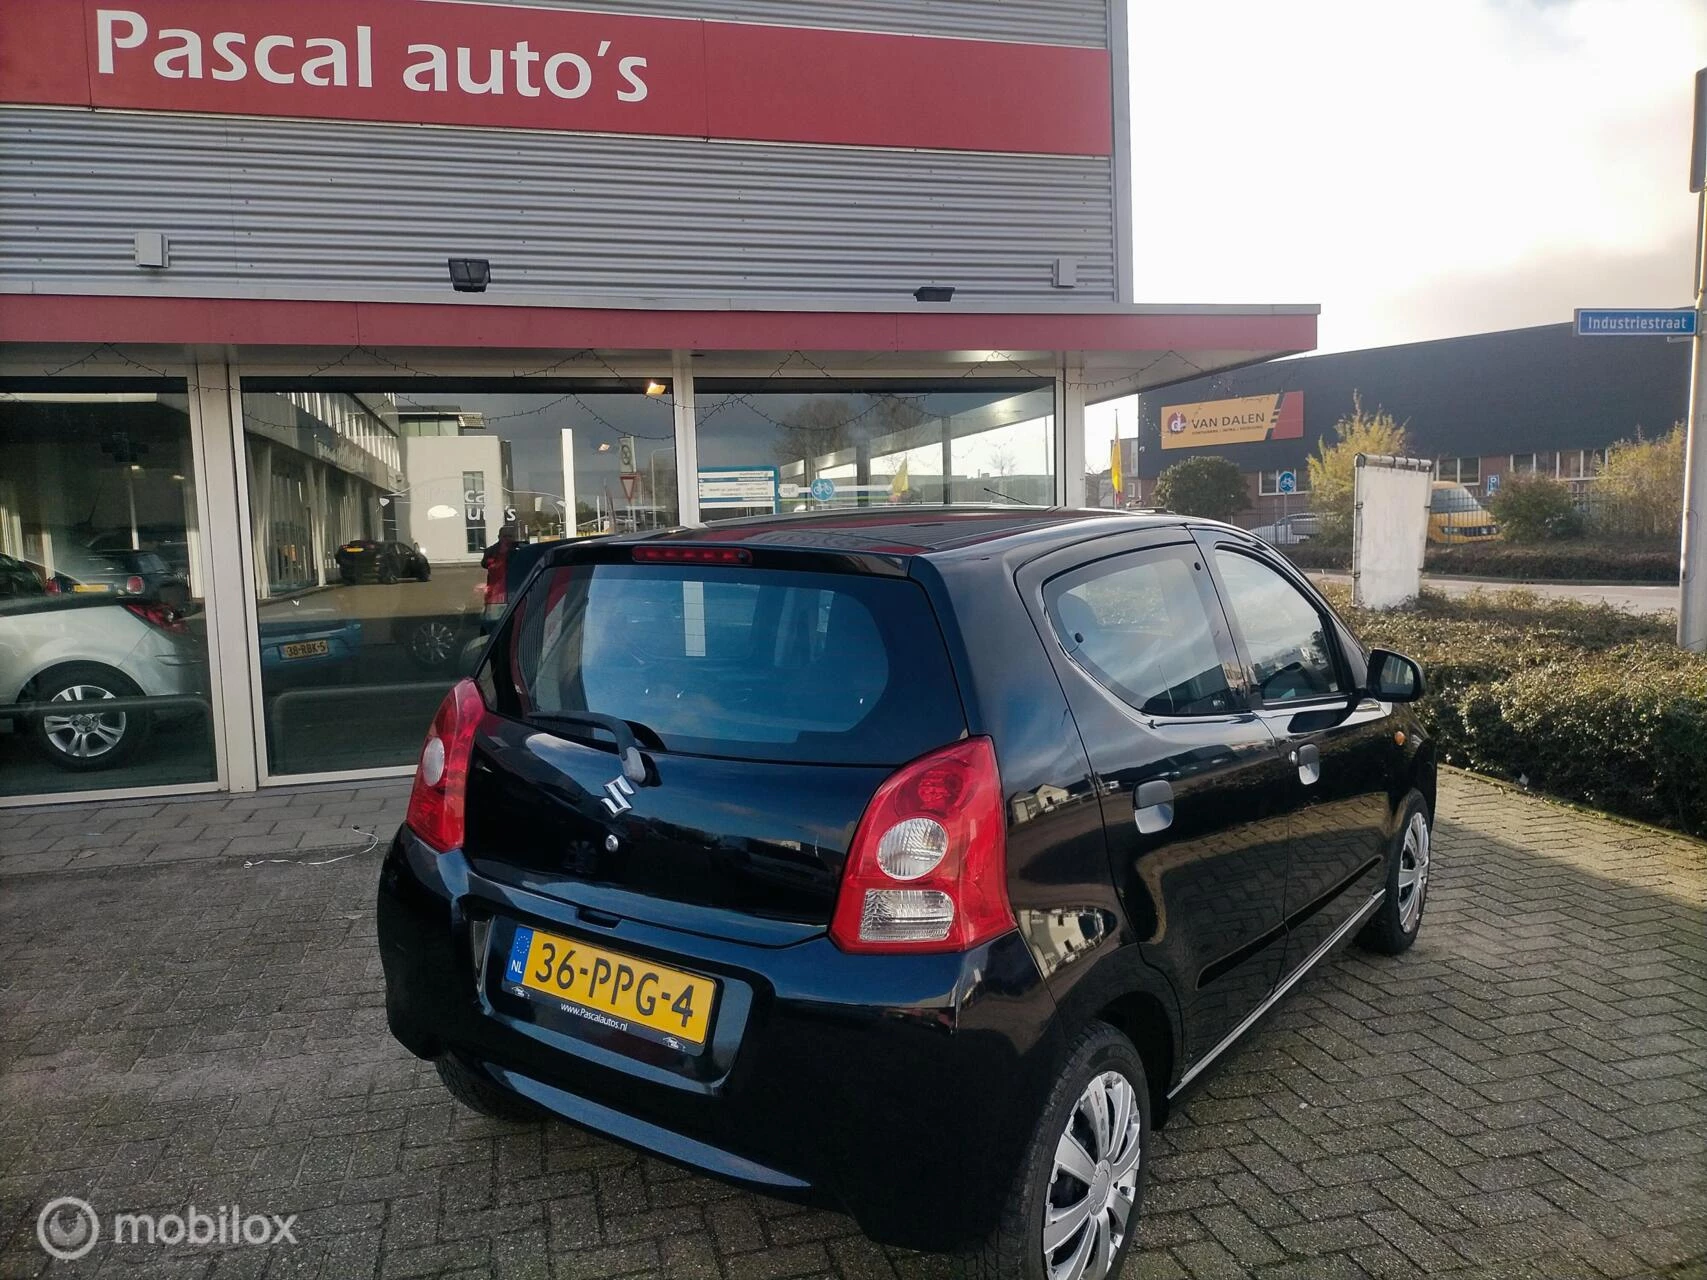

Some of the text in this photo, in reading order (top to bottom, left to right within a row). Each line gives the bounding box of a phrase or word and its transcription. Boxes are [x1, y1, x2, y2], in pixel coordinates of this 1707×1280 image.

[96, 8, 649, 103] Pascal auto's
[1587, 315, 1687, 330] Industriestraat
[1191, 411, 1265, 429] VAN DALEN
[510, 959, 524, 975] NL
[535, 942, 695, 1029] 36-PPG-4
[560, 1002, 629, 1032] www.Pascalautos.nl
